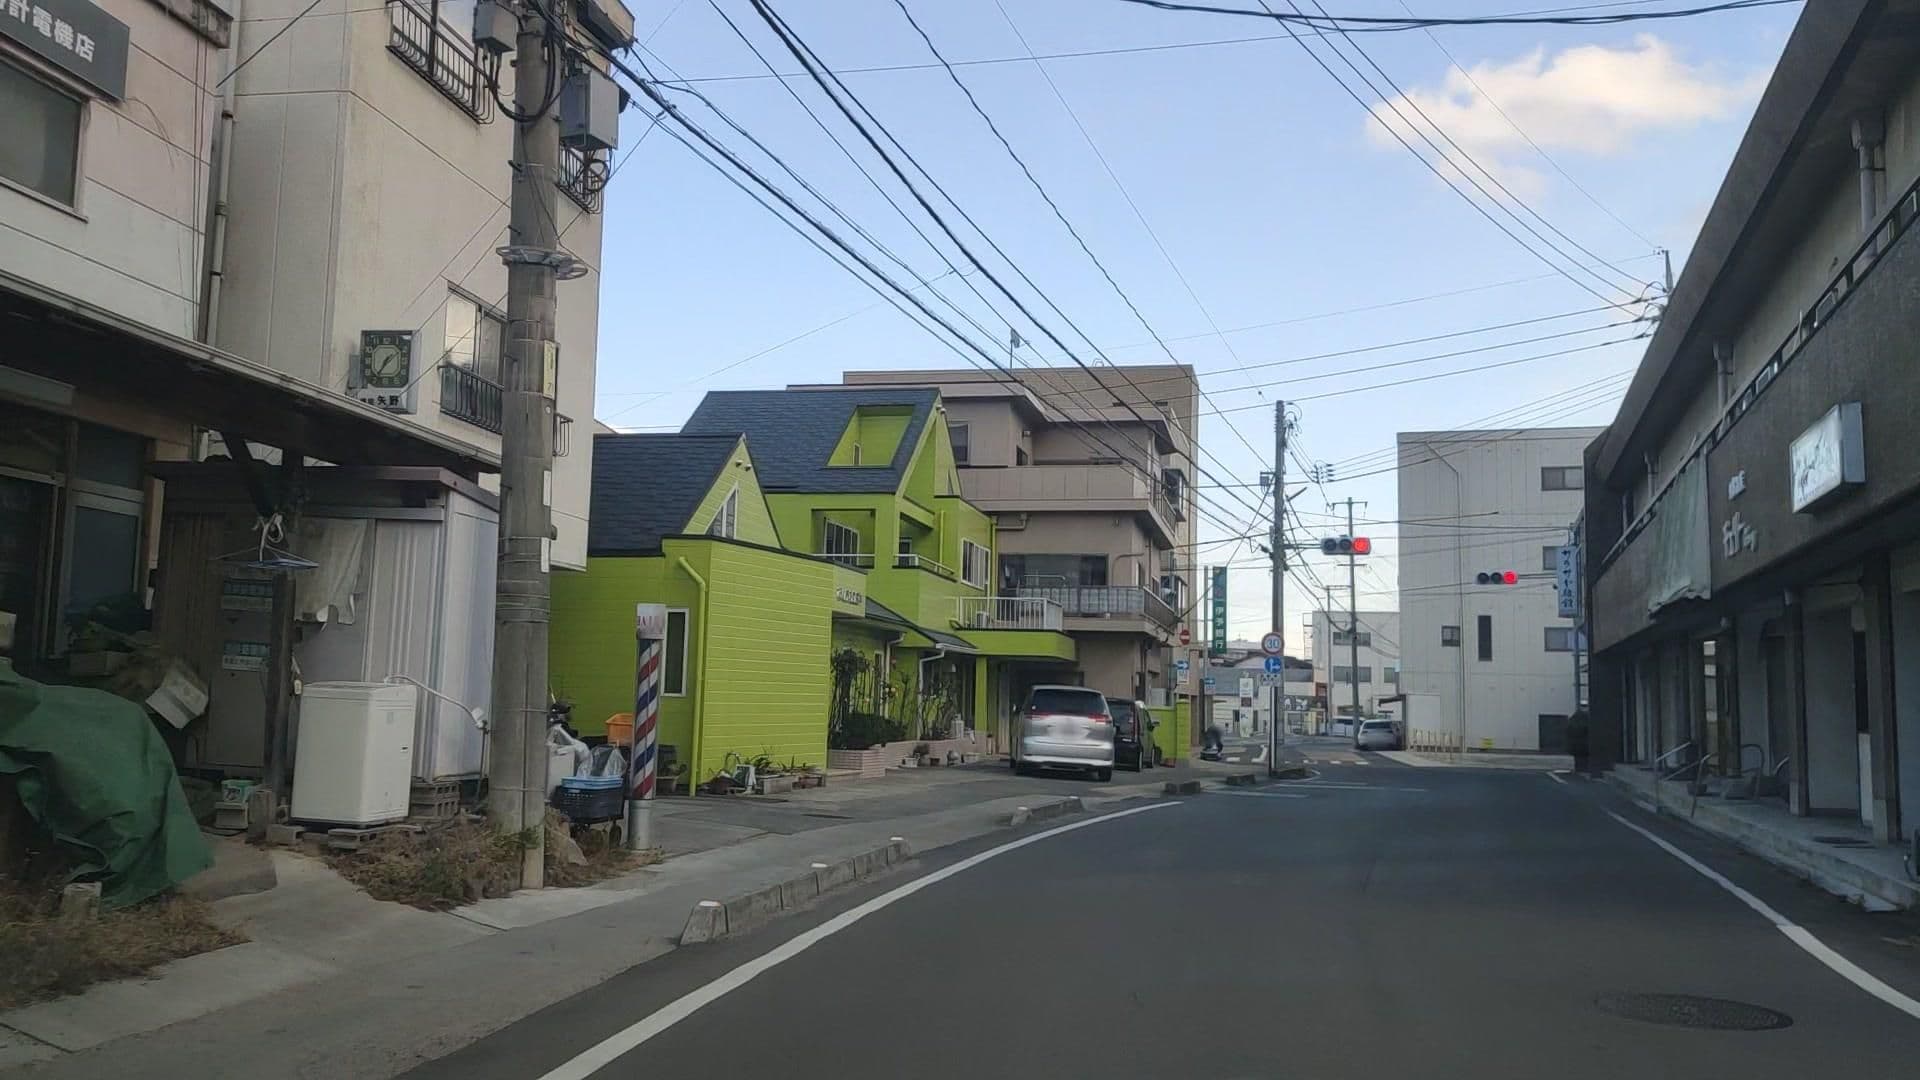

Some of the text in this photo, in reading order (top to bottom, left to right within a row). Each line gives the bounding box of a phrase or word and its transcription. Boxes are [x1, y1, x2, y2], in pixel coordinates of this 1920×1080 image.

[0, 0, 96, 63] 計電機店
[1214, 606, 1225, 649] 伊予銀行
[1267, 638, 1281, 649] 30
